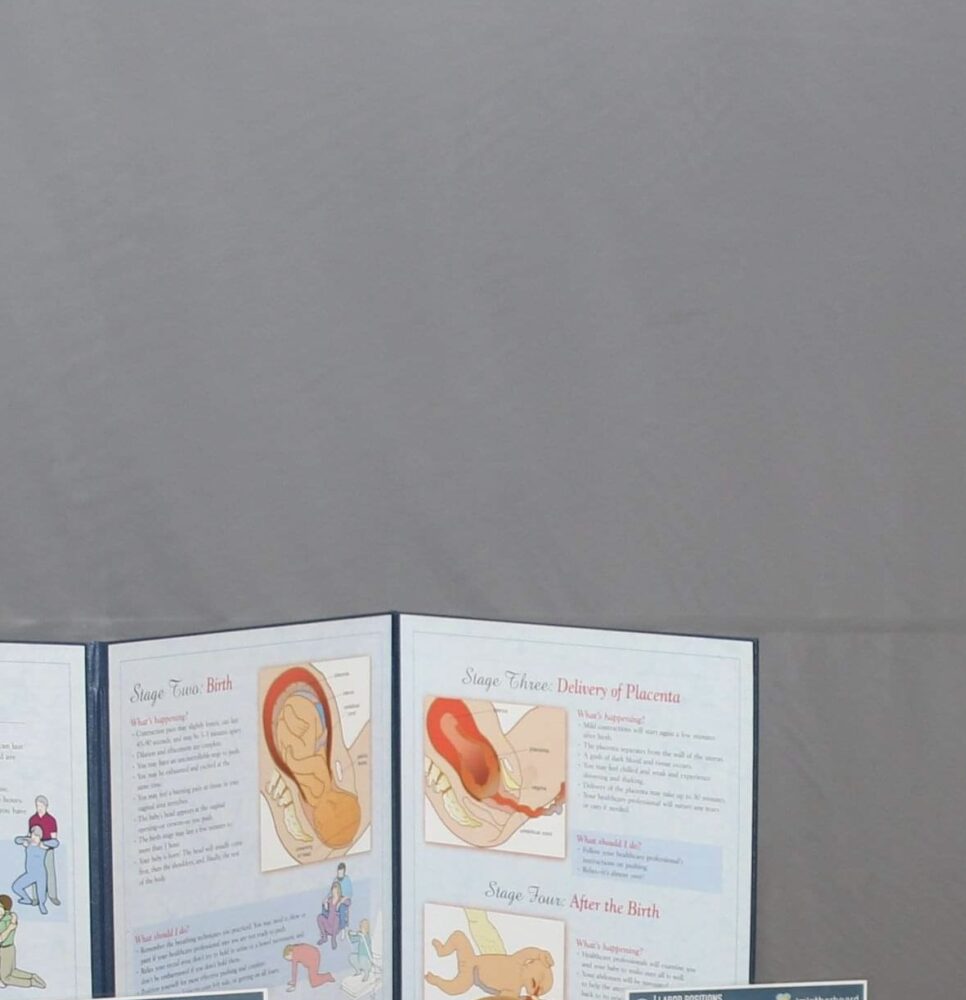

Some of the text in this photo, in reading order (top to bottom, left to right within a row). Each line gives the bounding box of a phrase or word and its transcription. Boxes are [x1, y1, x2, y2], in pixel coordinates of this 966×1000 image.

[130, 683, 164, 707] Stage
[207, 674, 233, 693] Birth
[461, 667, 500, 692] Stage
[557, 677, 608, 700] Delivery
[611, 682, 623, 702] of
[626, 684, 681, 703] Placenta
[576, 834, 595, 844] What
[598, 837, 620, 847] should
[485, 880, 525, 906] Stage
[570, 893, 600, 912] After
[604, 897, 624, 915] the
[627, 900, 661, 919] Birth
[135, 934, 152, 944] What
